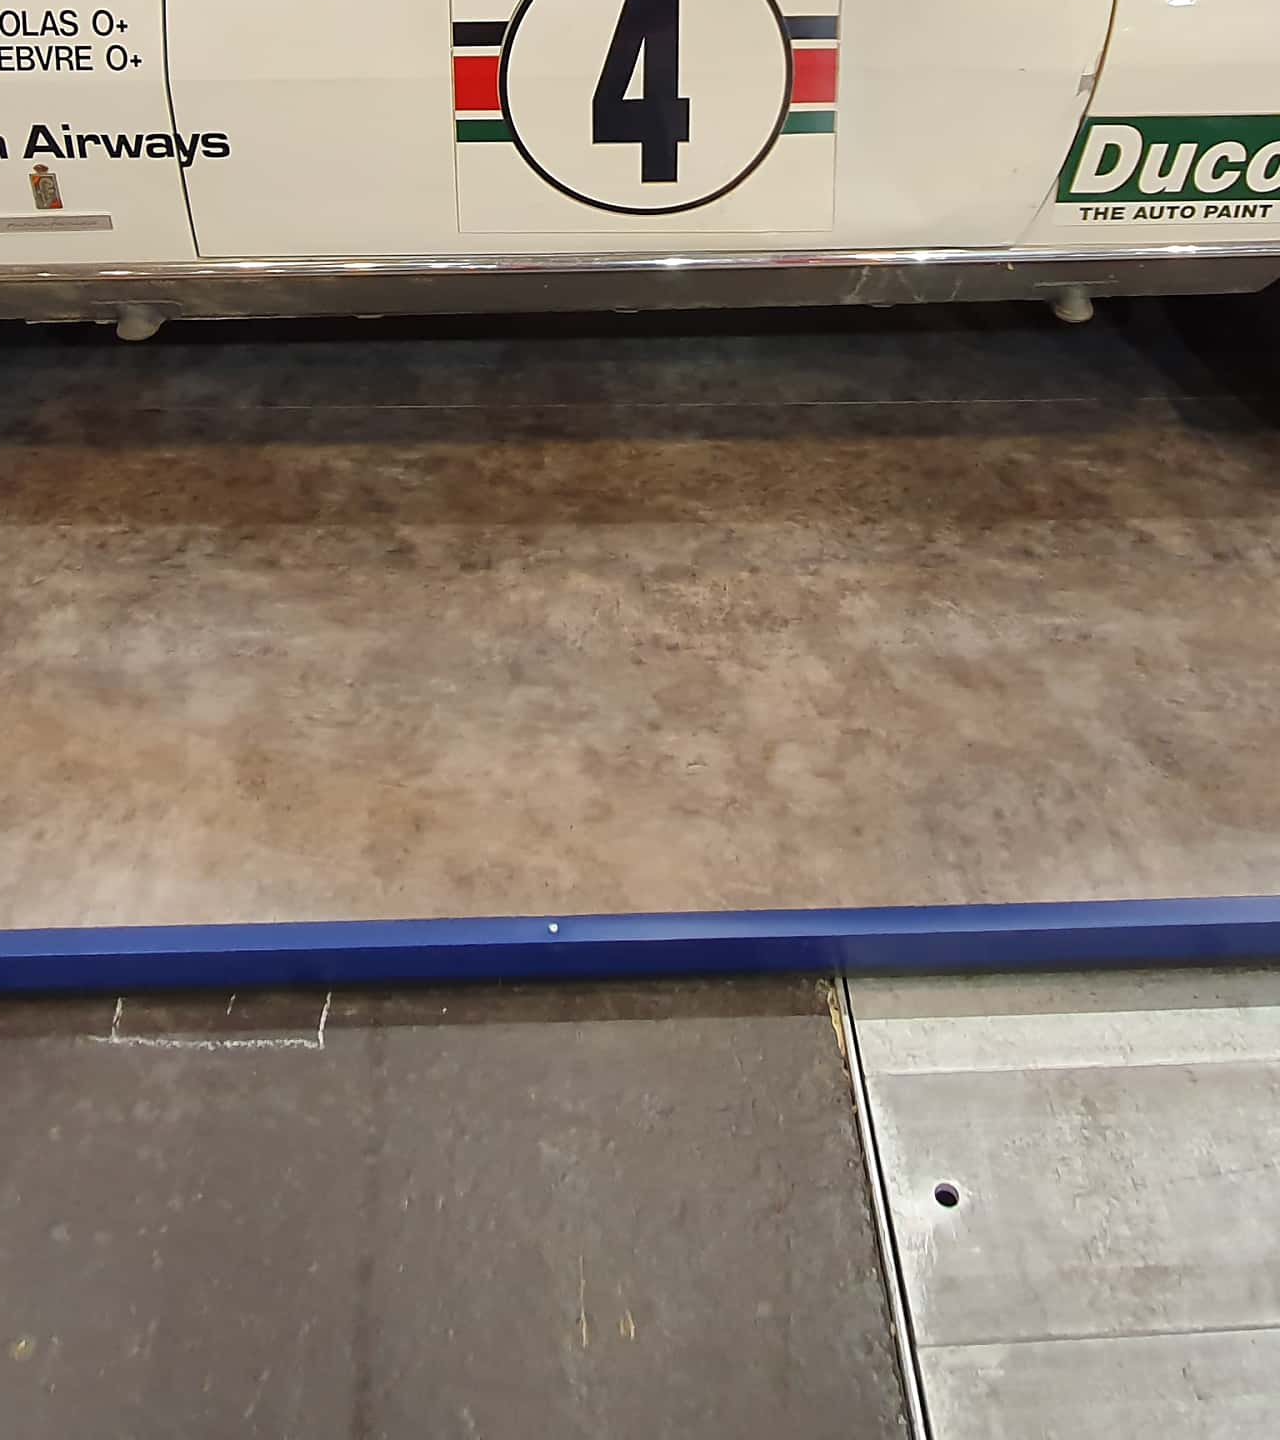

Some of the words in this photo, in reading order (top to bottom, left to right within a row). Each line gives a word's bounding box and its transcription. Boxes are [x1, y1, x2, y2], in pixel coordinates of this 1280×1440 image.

[92, 9, 128, 37] O+
[105, 44, 142, 71] O+
[23, 123, 231, 169] Airways
[1079, 206, 1125, 221] THE
[1133, 205, 1196, 220] AUTO
[1203, 204, 1273, 219] PAINT
